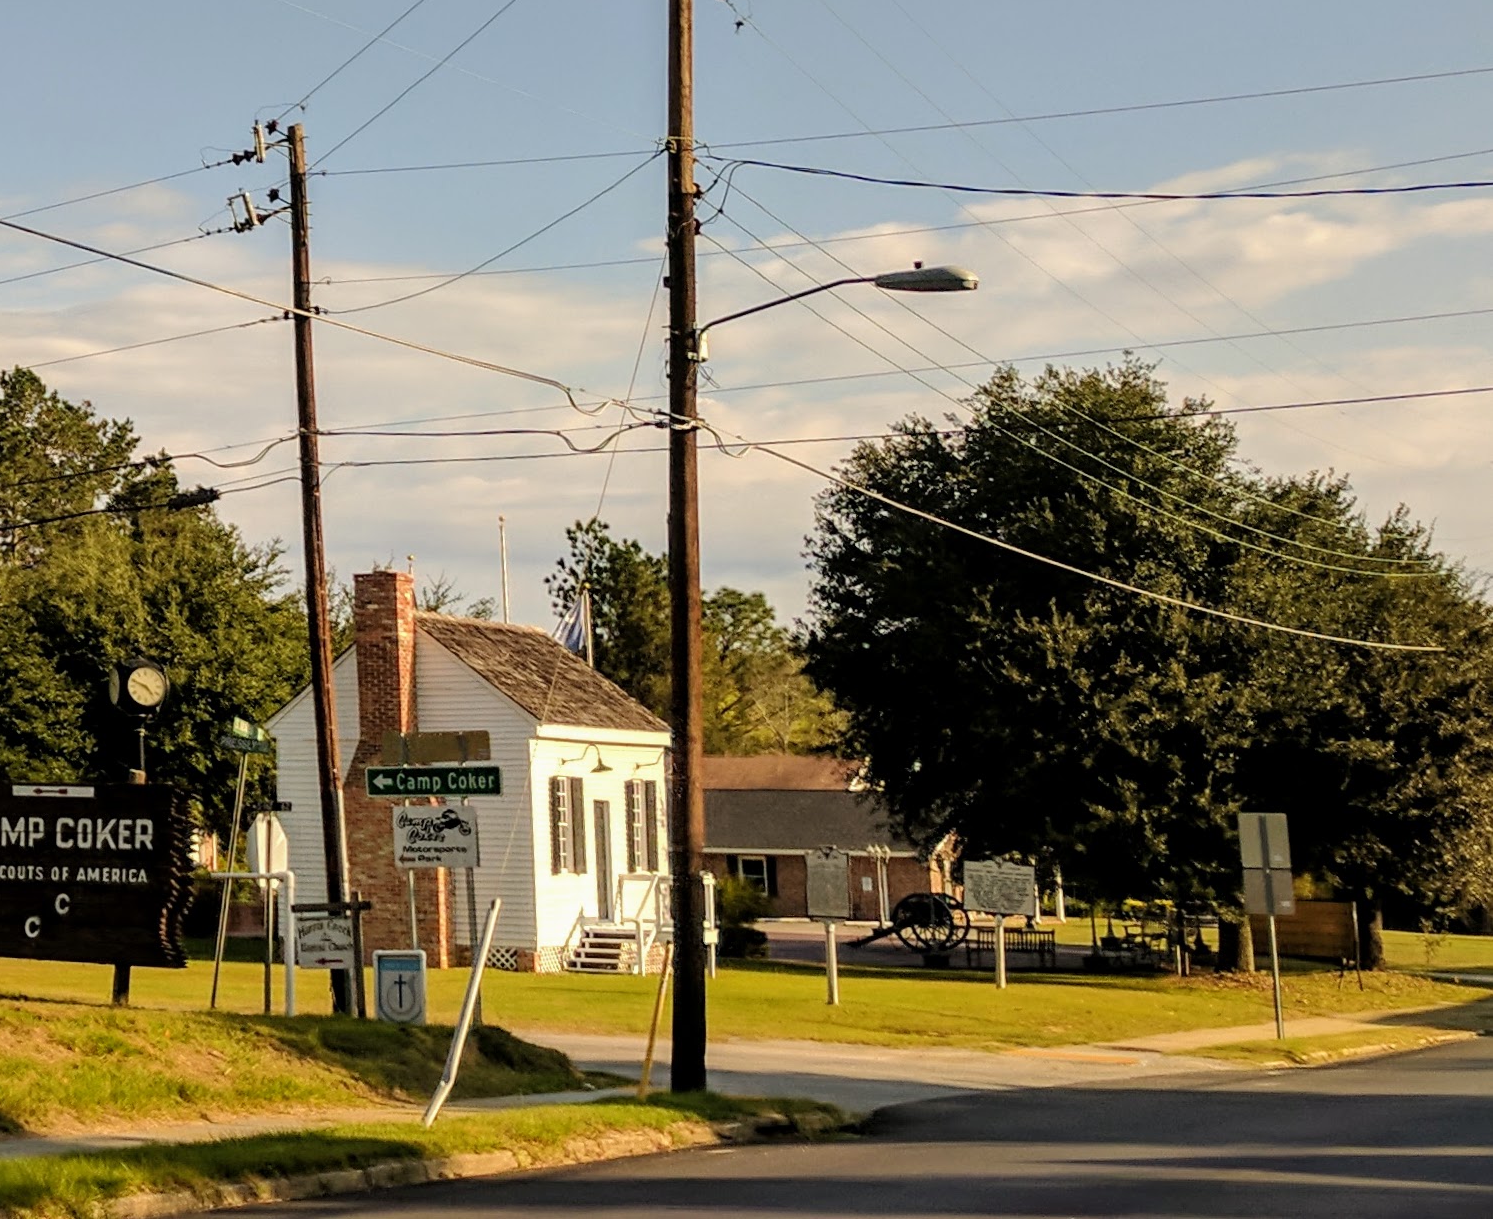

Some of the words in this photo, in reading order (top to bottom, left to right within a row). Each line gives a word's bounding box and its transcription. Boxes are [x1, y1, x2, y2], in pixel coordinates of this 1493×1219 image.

[396, 772, 441, 792] Camp
[447, 772, 495, 789] Coker
[56, 817, 154, 851] COKER
[402, 845, 468, 854] Motorsports
[417, 854, 442, 863] Park
[51, 866, 69, 881] OF
[76, 867, 148, 884] AMERICA
[55, 893, 70, 915] C
[24, 916, 41, 938] C
